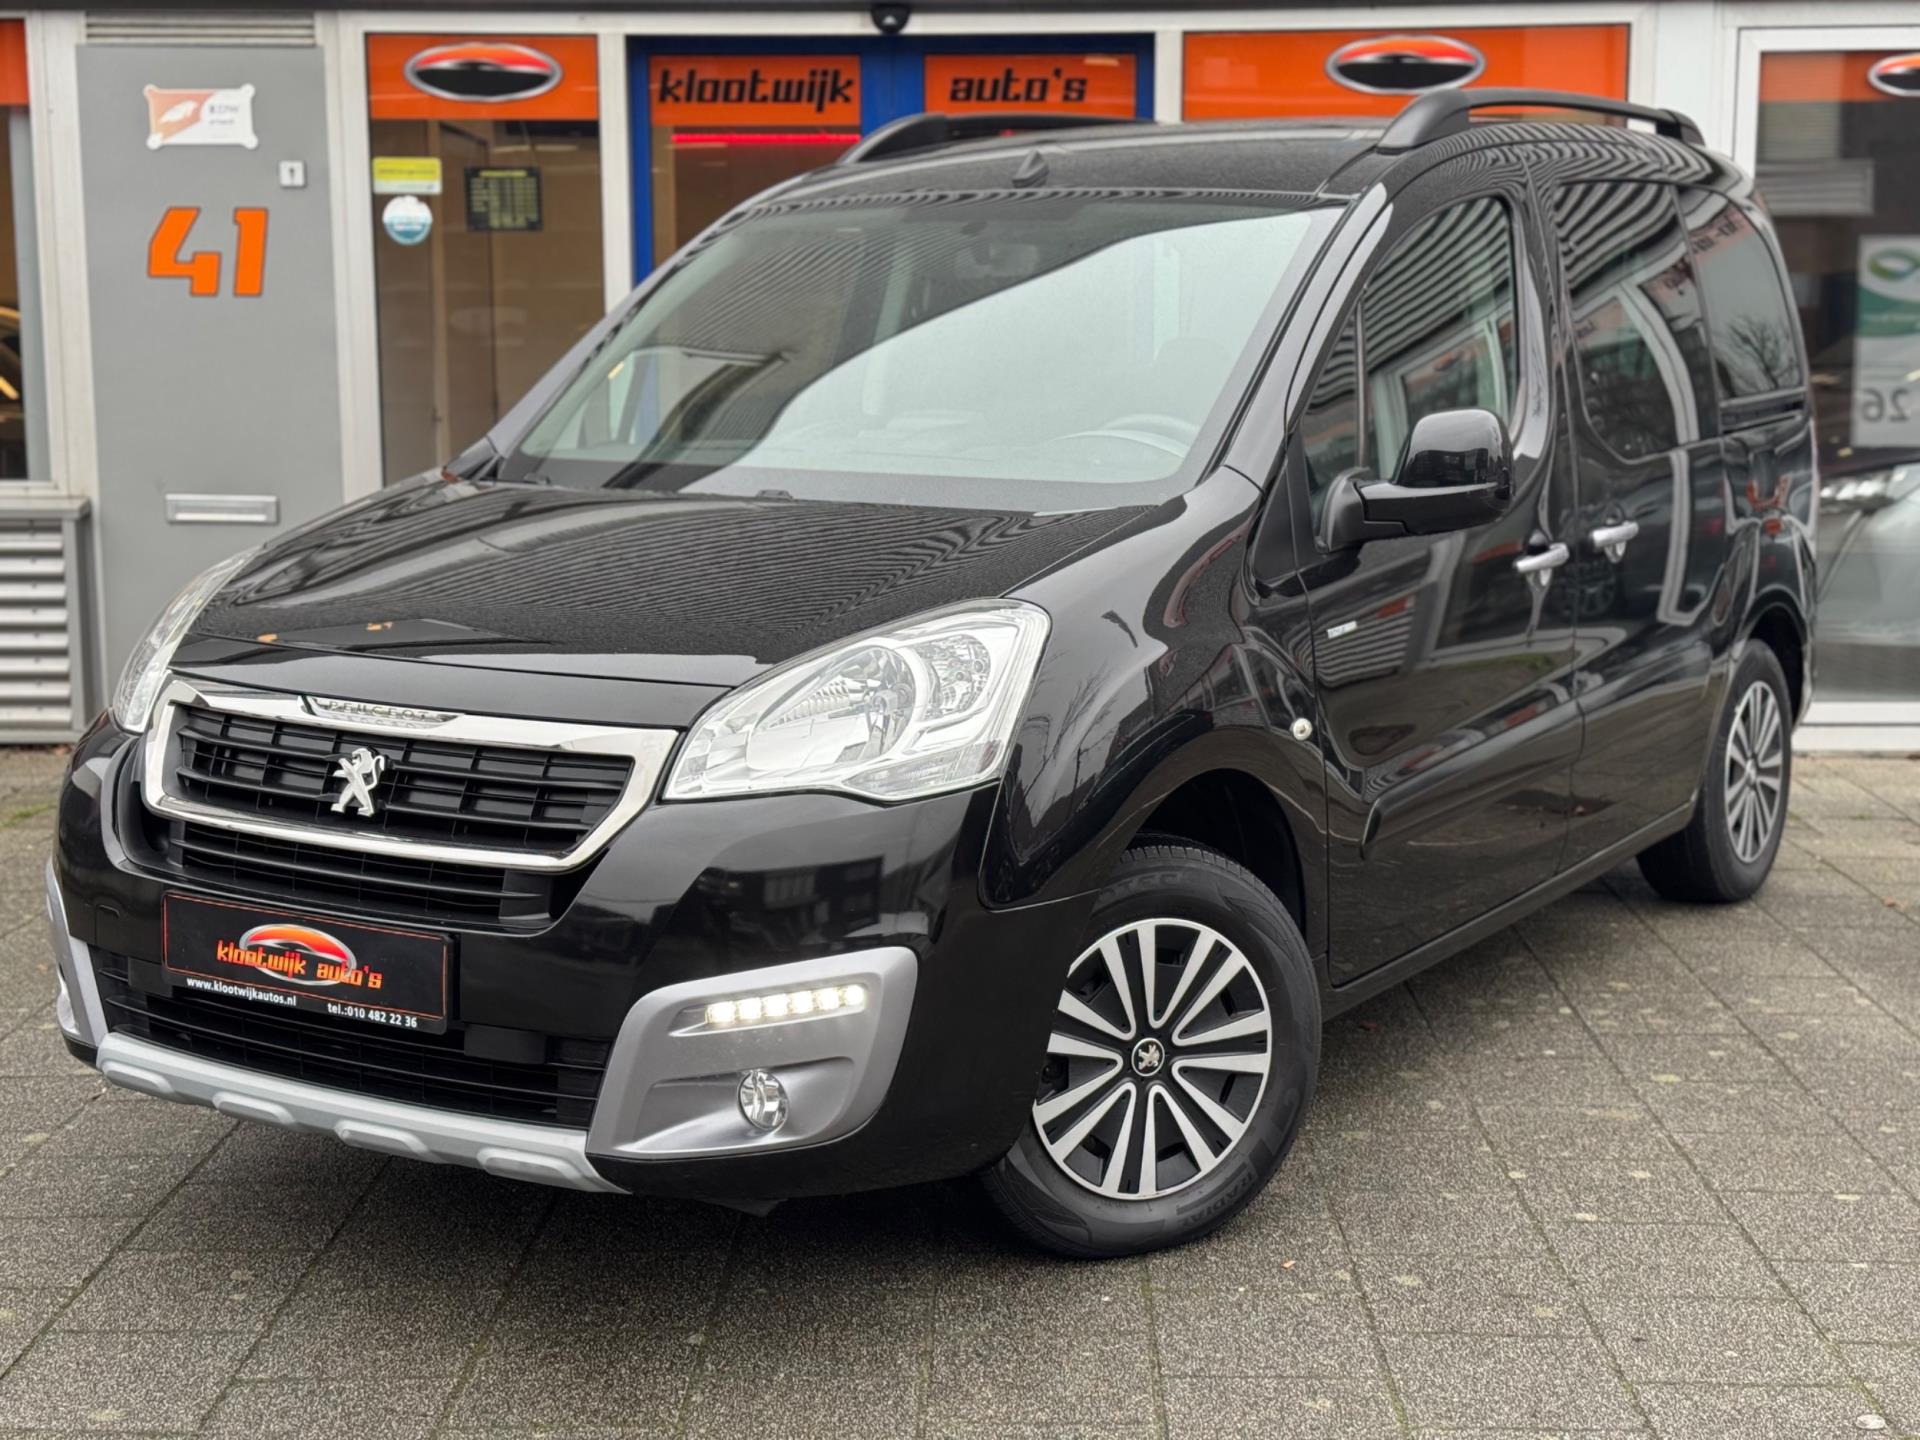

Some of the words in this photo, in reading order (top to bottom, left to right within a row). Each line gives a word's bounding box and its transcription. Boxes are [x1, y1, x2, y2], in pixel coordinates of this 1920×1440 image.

[659, 68, 853, 113] klootwijk
[949, 67, 1088, 102] auto's
[147, 206, 269, 298] 41
[328, 701, 429, 720] PEUGEOT
[216, 940, 306, 979] klootwijk
[316, 960, 383, 990] auto's
[186, 977, 297, 1007] www.klootwijkautos.nl
[367, 1008, 387, 1023] 482
[389, 1012, 402, 1026] 22
[404, 1015, 418, 1029] 36
